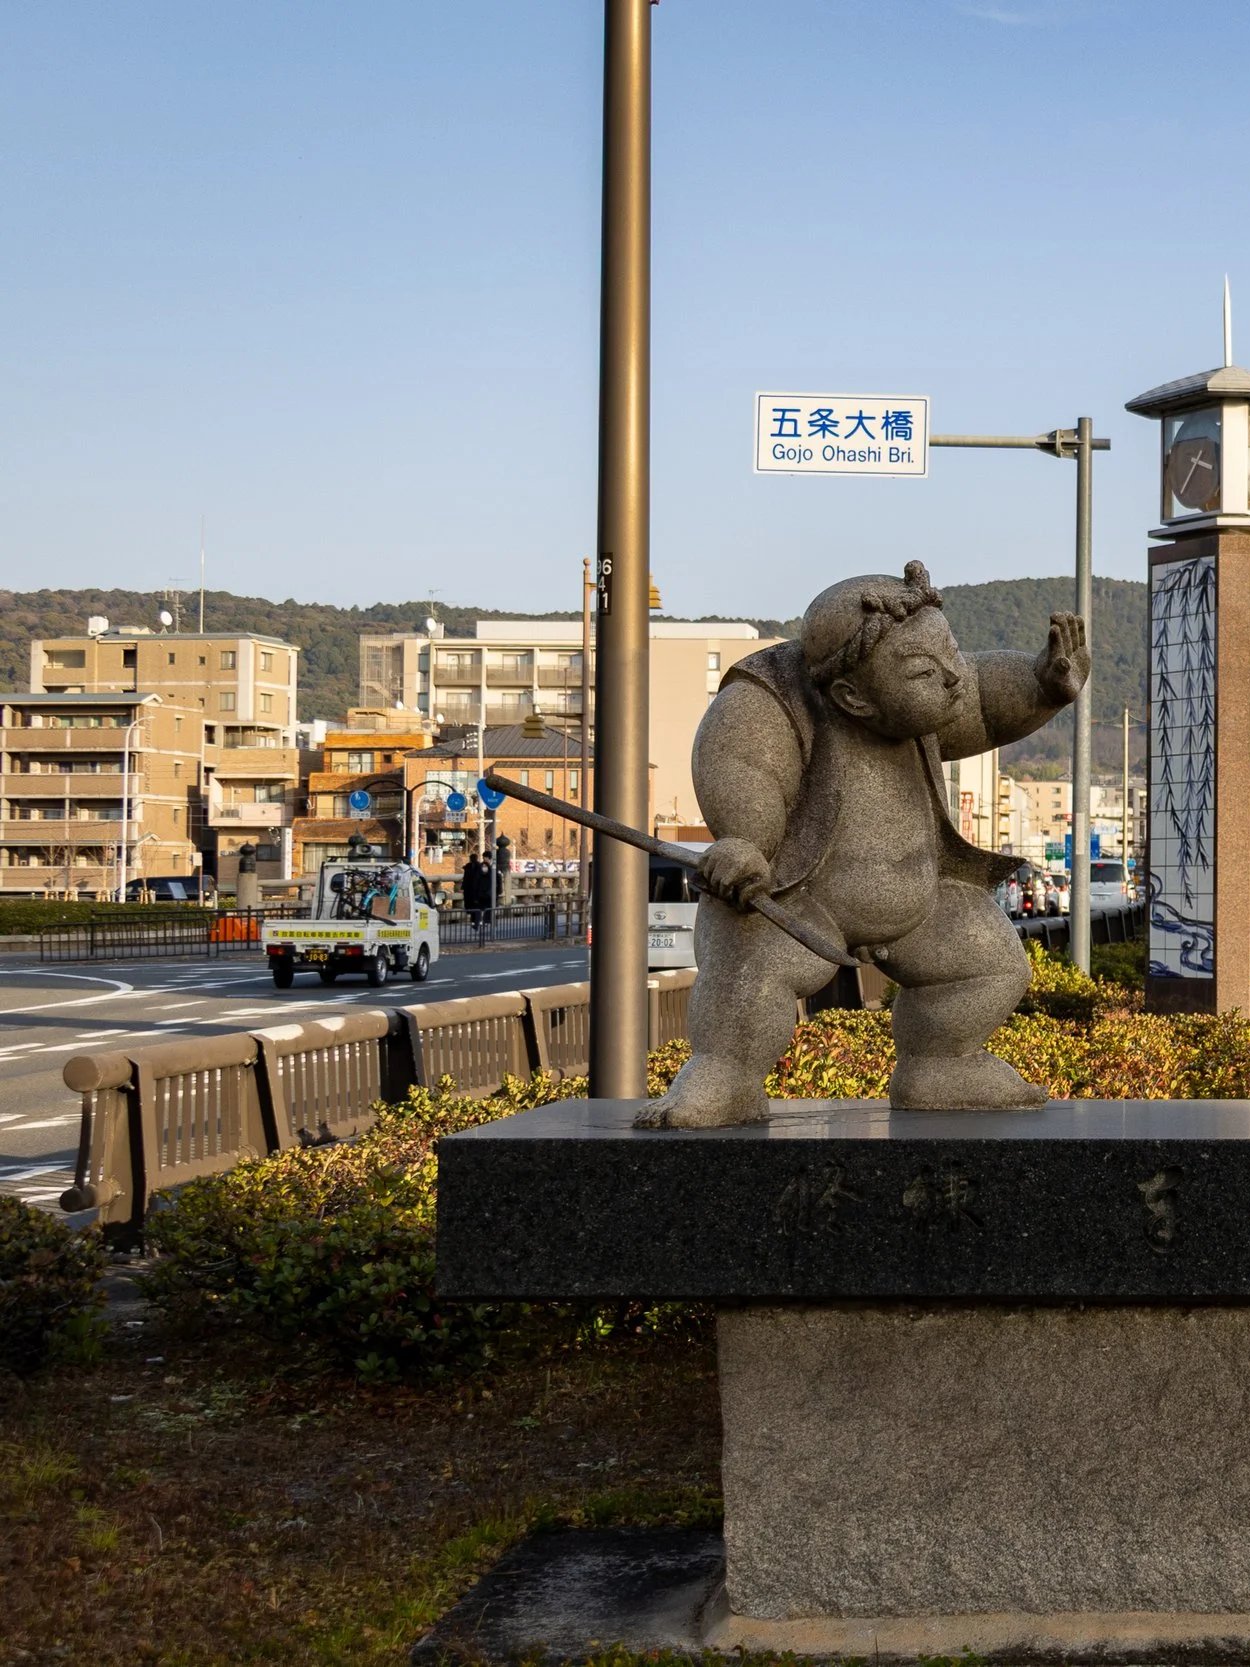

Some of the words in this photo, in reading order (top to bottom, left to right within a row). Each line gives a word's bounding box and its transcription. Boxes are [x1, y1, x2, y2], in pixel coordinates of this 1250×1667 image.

[770, 408, 914, 441] 五条大橋
[772, 443, 813, 464] Gojo
[822, 445, 881, 463] Ohashi
[889, 447, 914, 463] Bri.
[651, 938, 674, 947] 20-02
